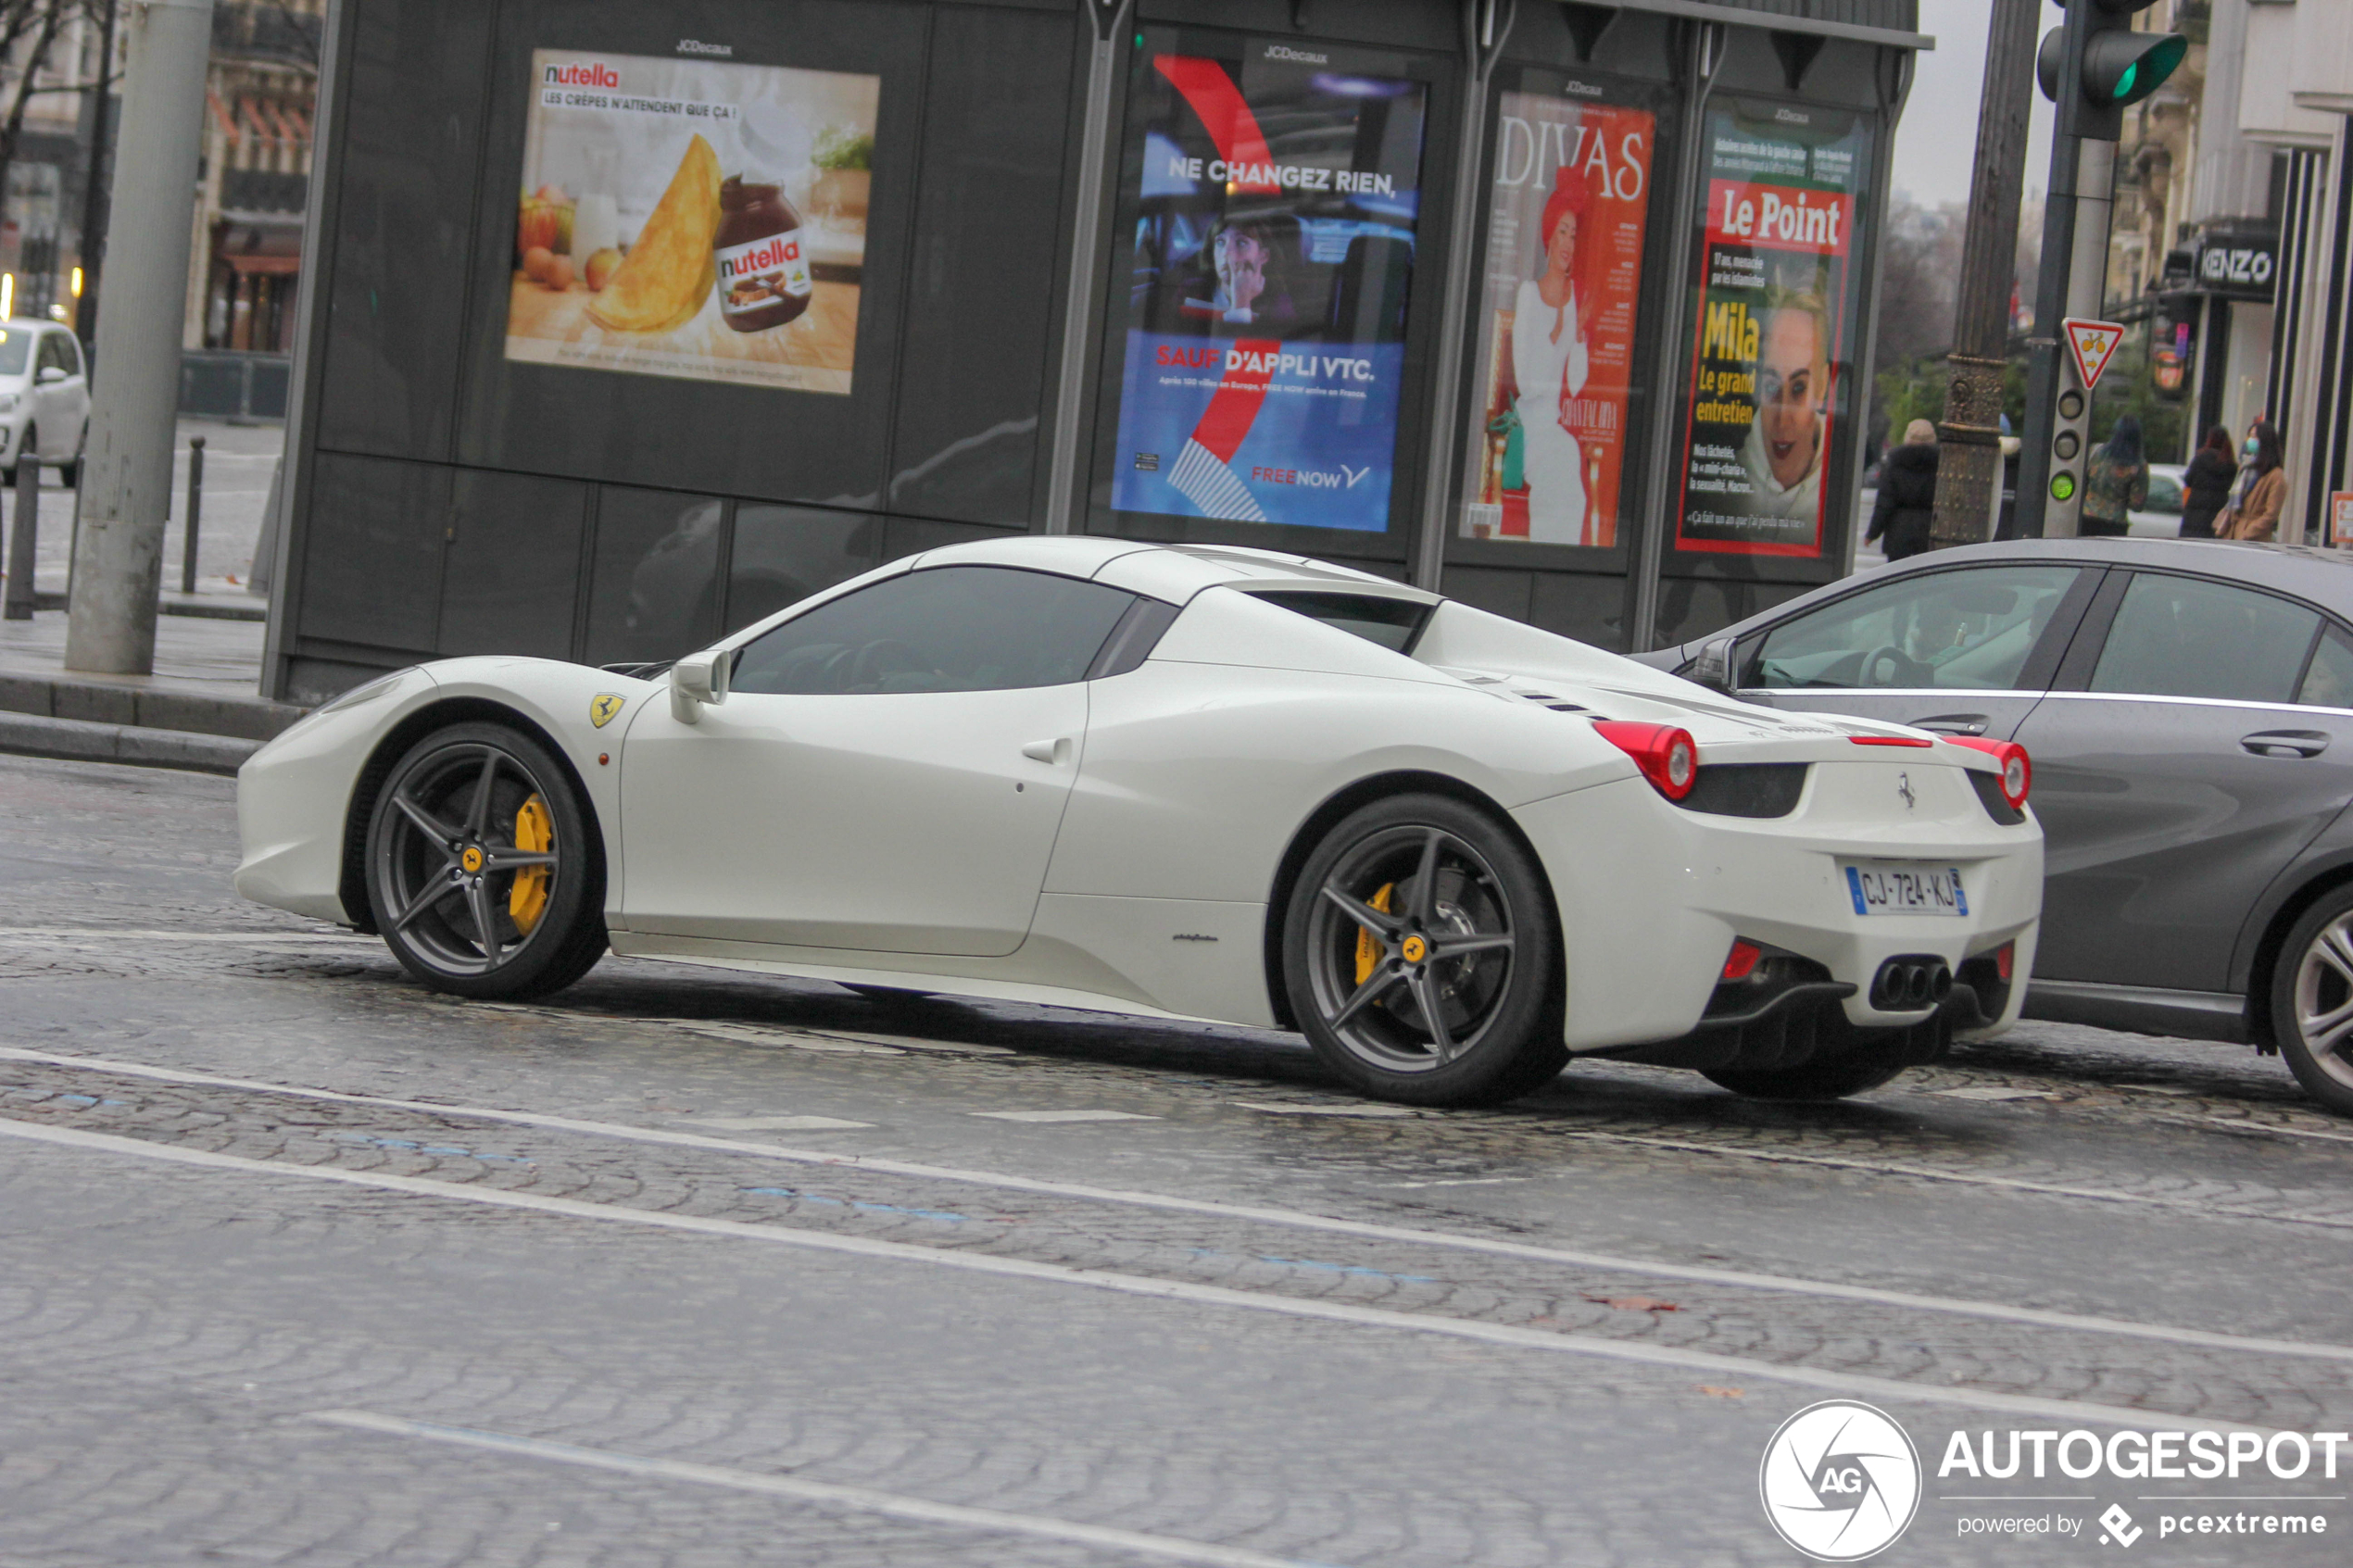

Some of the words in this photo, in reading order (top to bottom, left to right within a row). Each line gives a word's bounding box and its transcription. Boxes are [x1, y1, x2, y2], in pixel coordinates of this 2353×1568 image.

[675, 39, 732, 55] JCDecaux
[1264, 45, 1327, 64] JCDecaux
[545, 63, 619, 87] nutella
[545, 92, 561, 105] LES
[565, 91, 607, 107] CRÊPES
[611, 97, 682, 114] N'ATTENDENT
[686, 103, 709, 117] QUE
[713, 106, 729, 120] ÇA
[1495, 116, 1643, 201] DIVAS
[1168, 157, 1202, 179] NE
[1208, 159, 1330, 190] CHANGEZ
[1335, 170, 1397, 198] RIEN,
[1721, 189, 1754, 236] Le
[1757, 192, 1840, 246] Point
[721, 238, 799, 278] nutella
[2201, 248, 2271, 283] KENZO
[1703, 301, 1760, 362] Mila
[1155, 345, 1220, 369] SAUF
[1225, 349, 1317, 377] D'APPLI
[1323, 357, 1375, 382] VTC.
[1159, 376, 1182, 385] Après
[1198, 378, 1218, 387] villes
[1262, 383, 1282, 392] FREE
[1283, 384, 1304, 393] NOW
[1698, 365, 1715, 391] Le
[1718, 368, 1756, 396] grand
[1696, 398, 1754, 424] entretien
[1693, 443, 1706, 456] Nos
[1691, 459, 1698, 473] la
[1689, 477, 1696, 490] la
[1862, 873, 1955, 907] CJ-724-KJ
